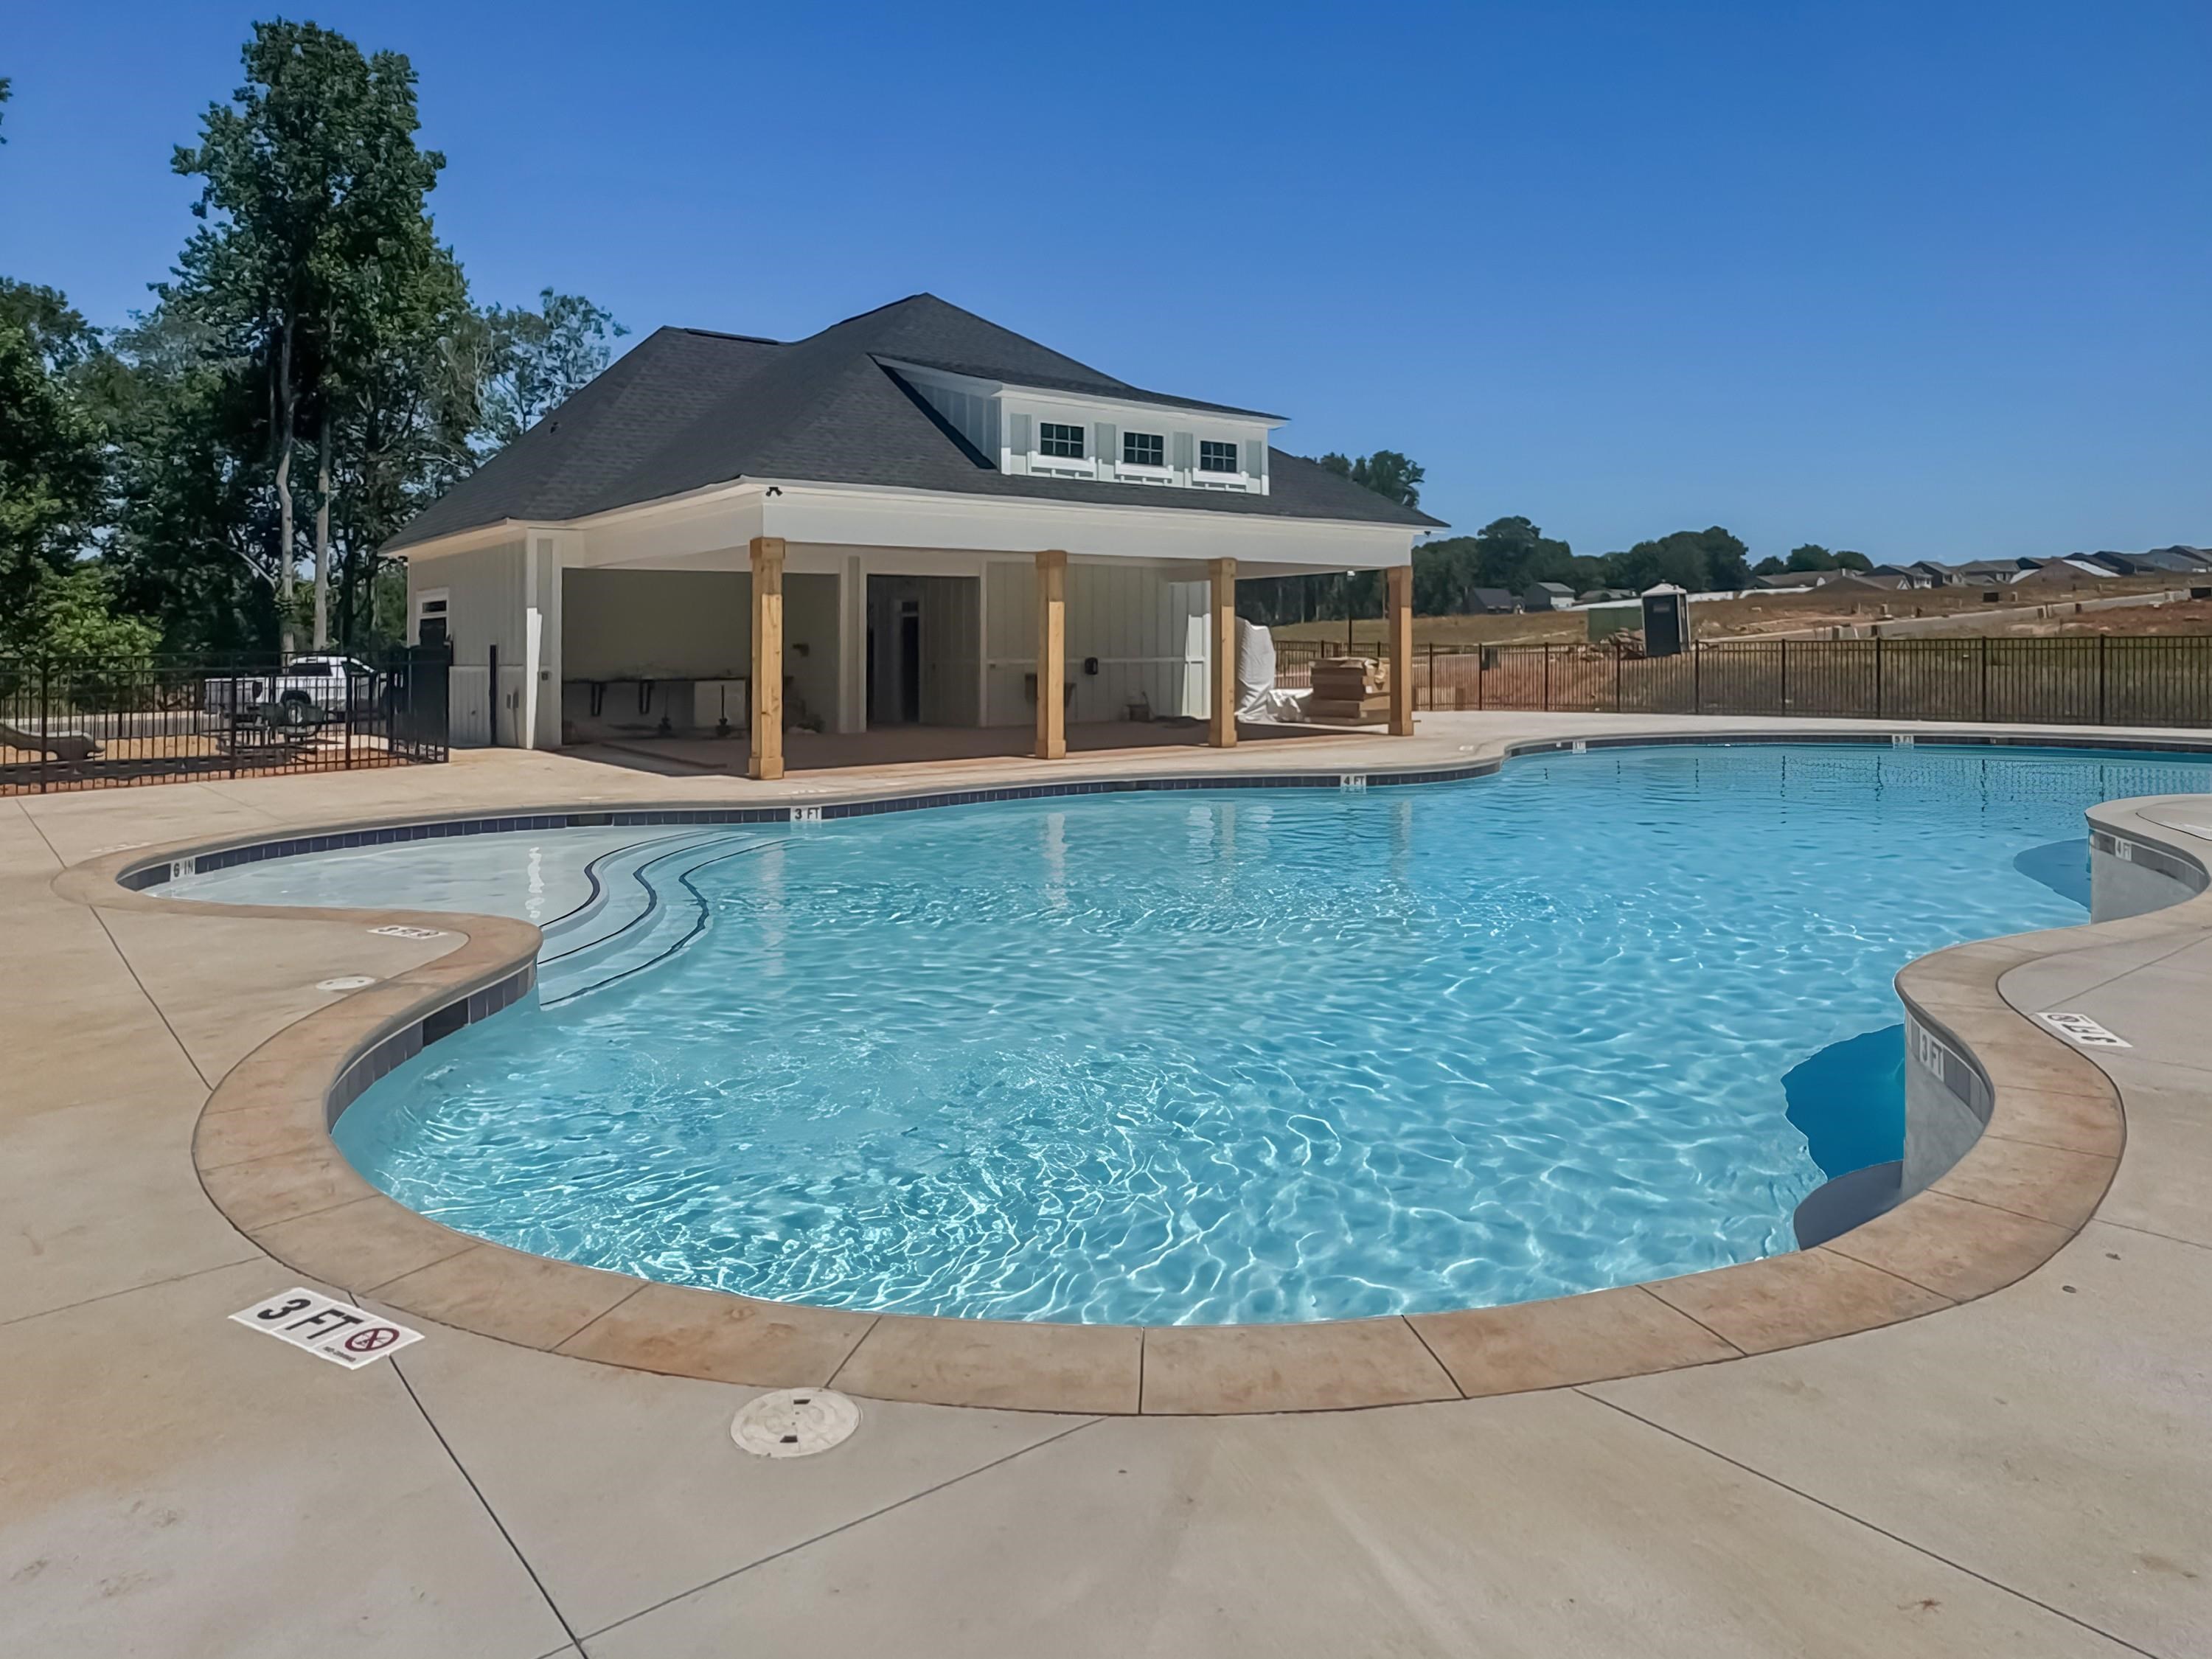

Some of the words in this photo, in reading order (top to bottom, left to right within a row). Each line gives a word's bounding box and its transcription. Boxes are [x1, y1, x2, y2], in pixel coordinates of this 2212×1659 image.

[1343, 776, 1350, 785] 4
[1354, 776, 1364, 785] FT
[795, 808, 802, 820] 3
[807, 807, 820, 819] FT
[173, 863, 180, 877] 6
[184, 860, 194, 875] IN
[1931, 1040, 1943, 1076] FT
[257, 1298, 311, 1320] 3
[285, 1308, 364, 1340] FT
